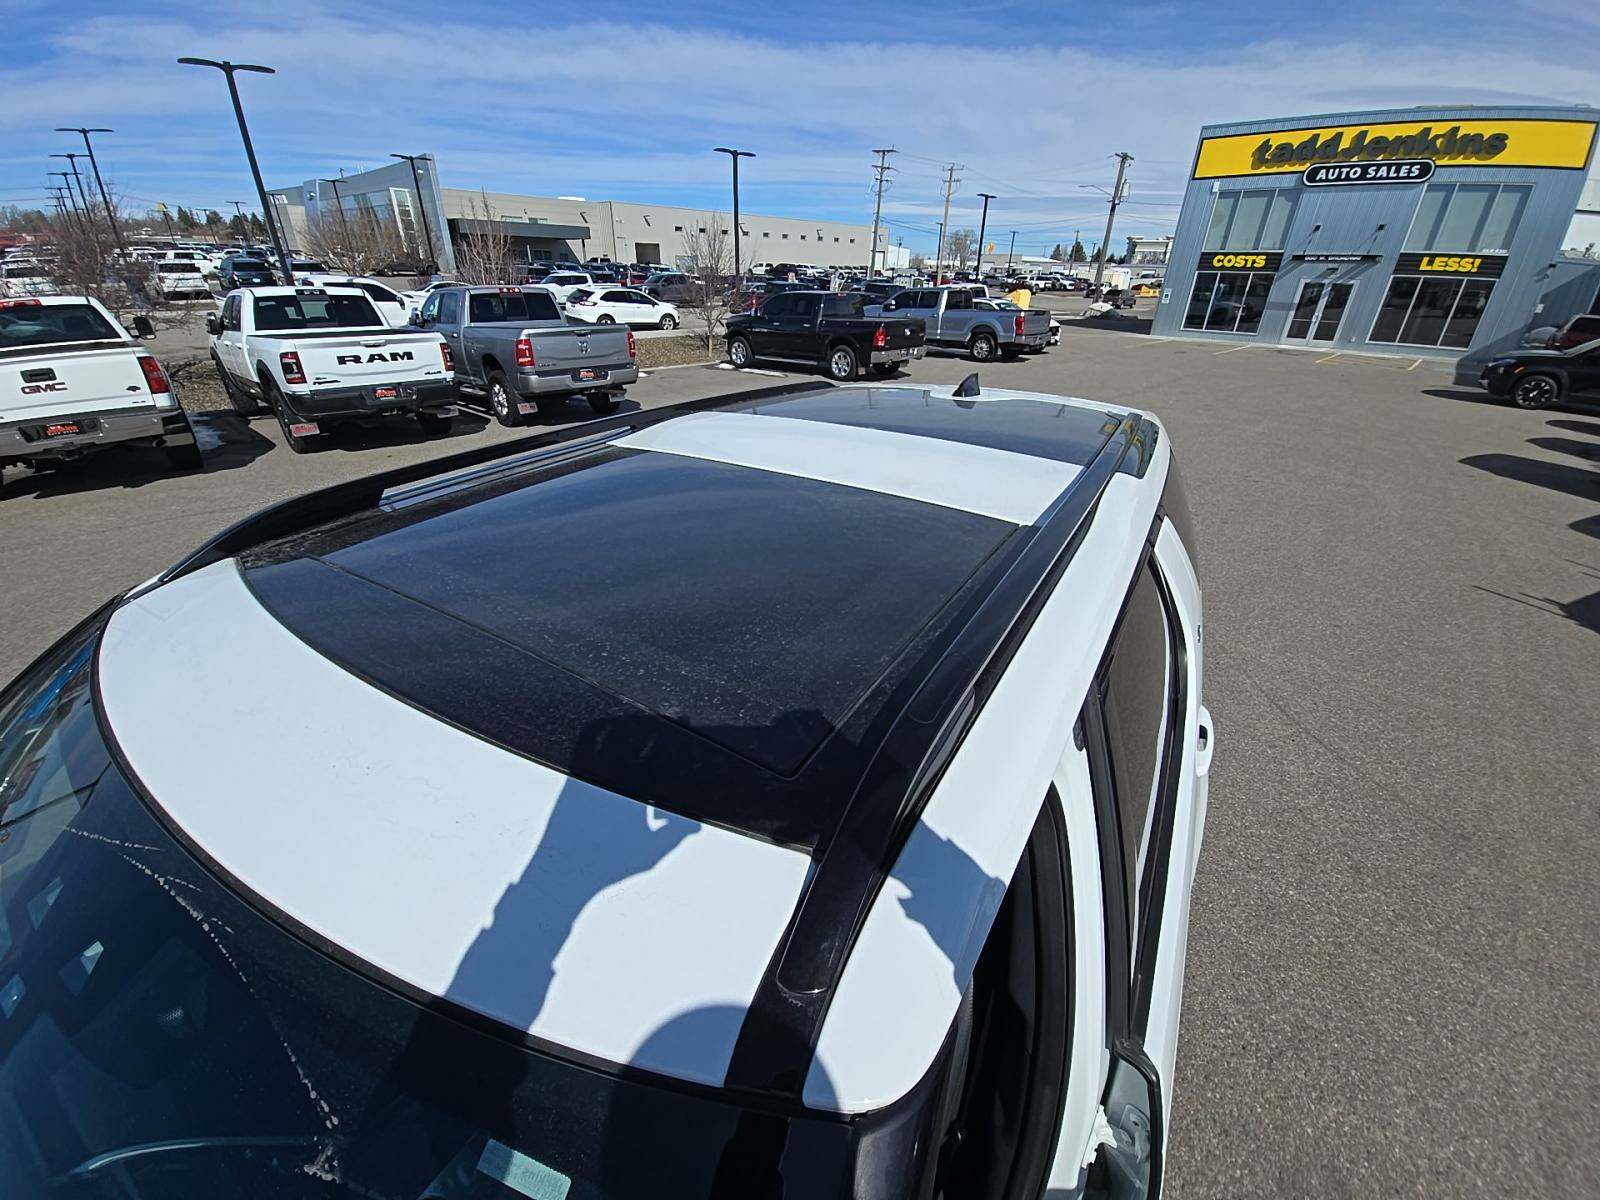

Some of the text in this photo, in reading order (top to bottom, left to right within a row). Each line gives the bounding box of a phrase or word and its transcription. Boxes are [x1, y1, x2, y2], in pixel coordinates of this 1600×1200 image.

[1316, 164, 1420, 181] AUTO SALES
[1212, 254, 1266, 268] COSTS
[1419, 256, 1482, 273] LESS!
[336, 351, 414, 366] RAM
[20, 381, 68, 395] GMC
